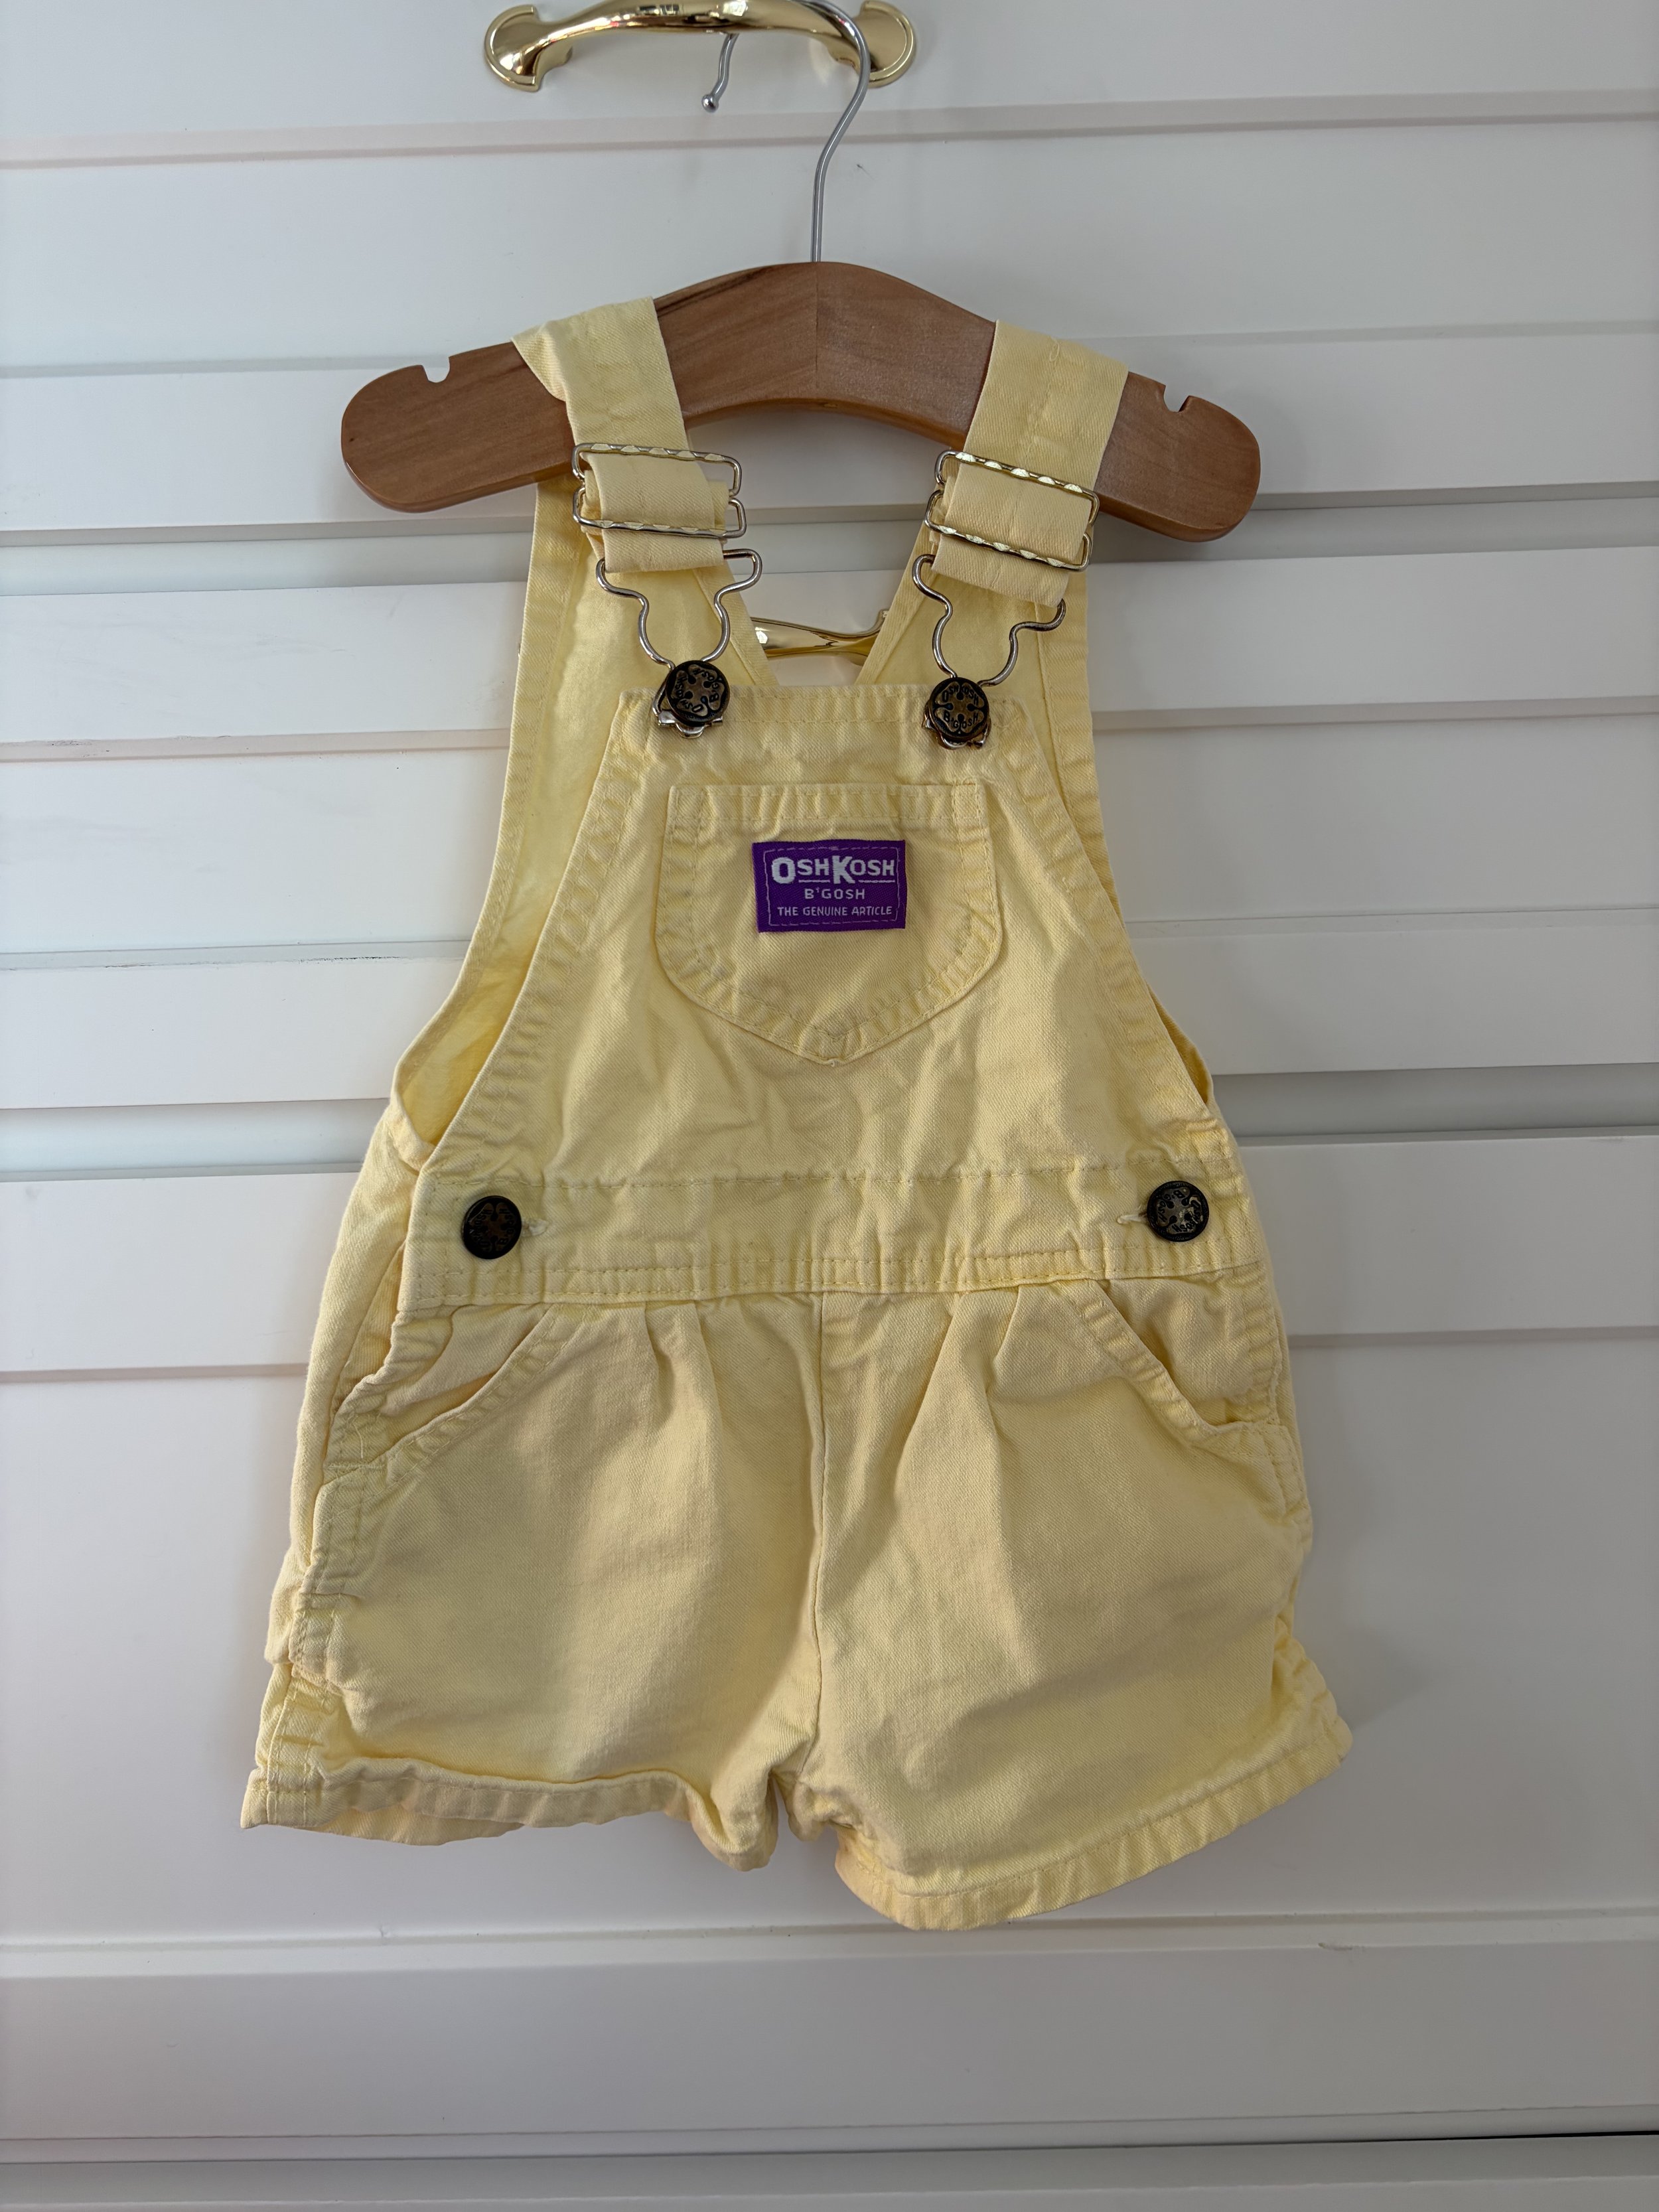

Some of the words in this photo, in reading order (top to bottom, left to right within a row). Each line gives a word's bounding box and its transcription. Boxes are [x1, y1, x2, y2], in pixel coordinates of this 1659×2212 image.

[675, 676, 704, 713] OSHOSH
[944, 710, 978, 728] B'GOSH
[772, 855, 895, 884] OSHKOSH
[804, 887, 865, 899] B'GOSH
[778, 907, 798, 917] THE
[803, 907, 847, 916] GENUINE
[851, 907, 892, 915] ARTICLE
